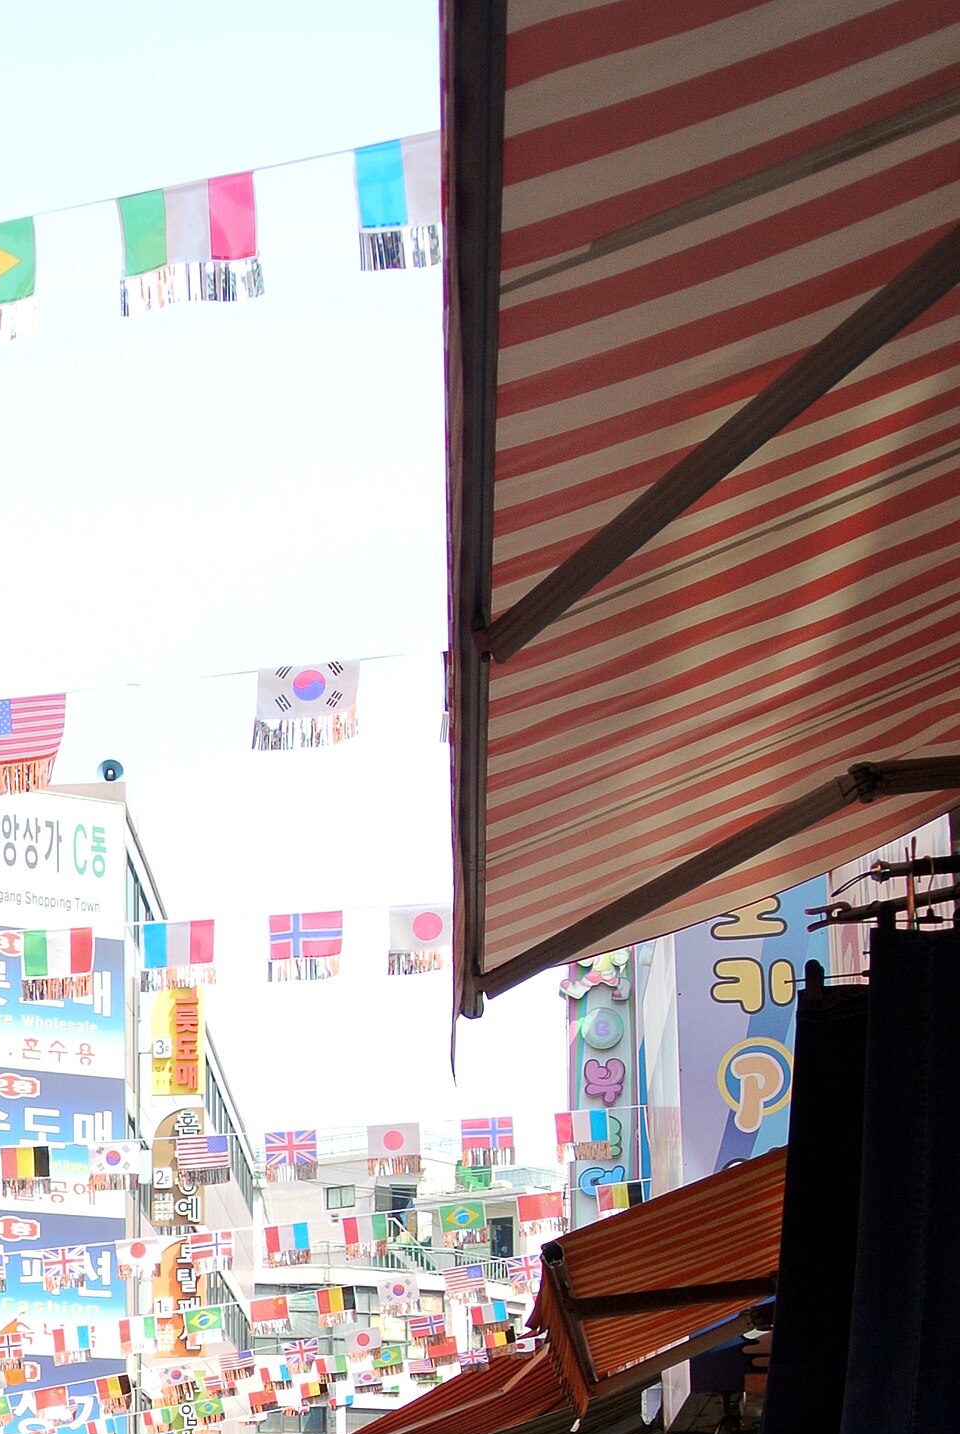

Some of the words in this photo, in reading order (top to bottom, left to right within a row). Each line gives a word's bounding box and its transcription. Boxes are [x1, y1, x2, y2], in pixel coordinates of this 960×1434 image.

[73, 823, 107, 878] C동
[25, 888, 71, 911] Shopping
[75, 897, 101, 913] Town
[22, 1013, 99, 1034] Wholesale
[156, 1039, 171, 1055] 3F
[175, 1111, 201, 1222] 혼예
[156, 1170, 170, 1185] 2F
[2, 1297, 101, 1315] Fashion
